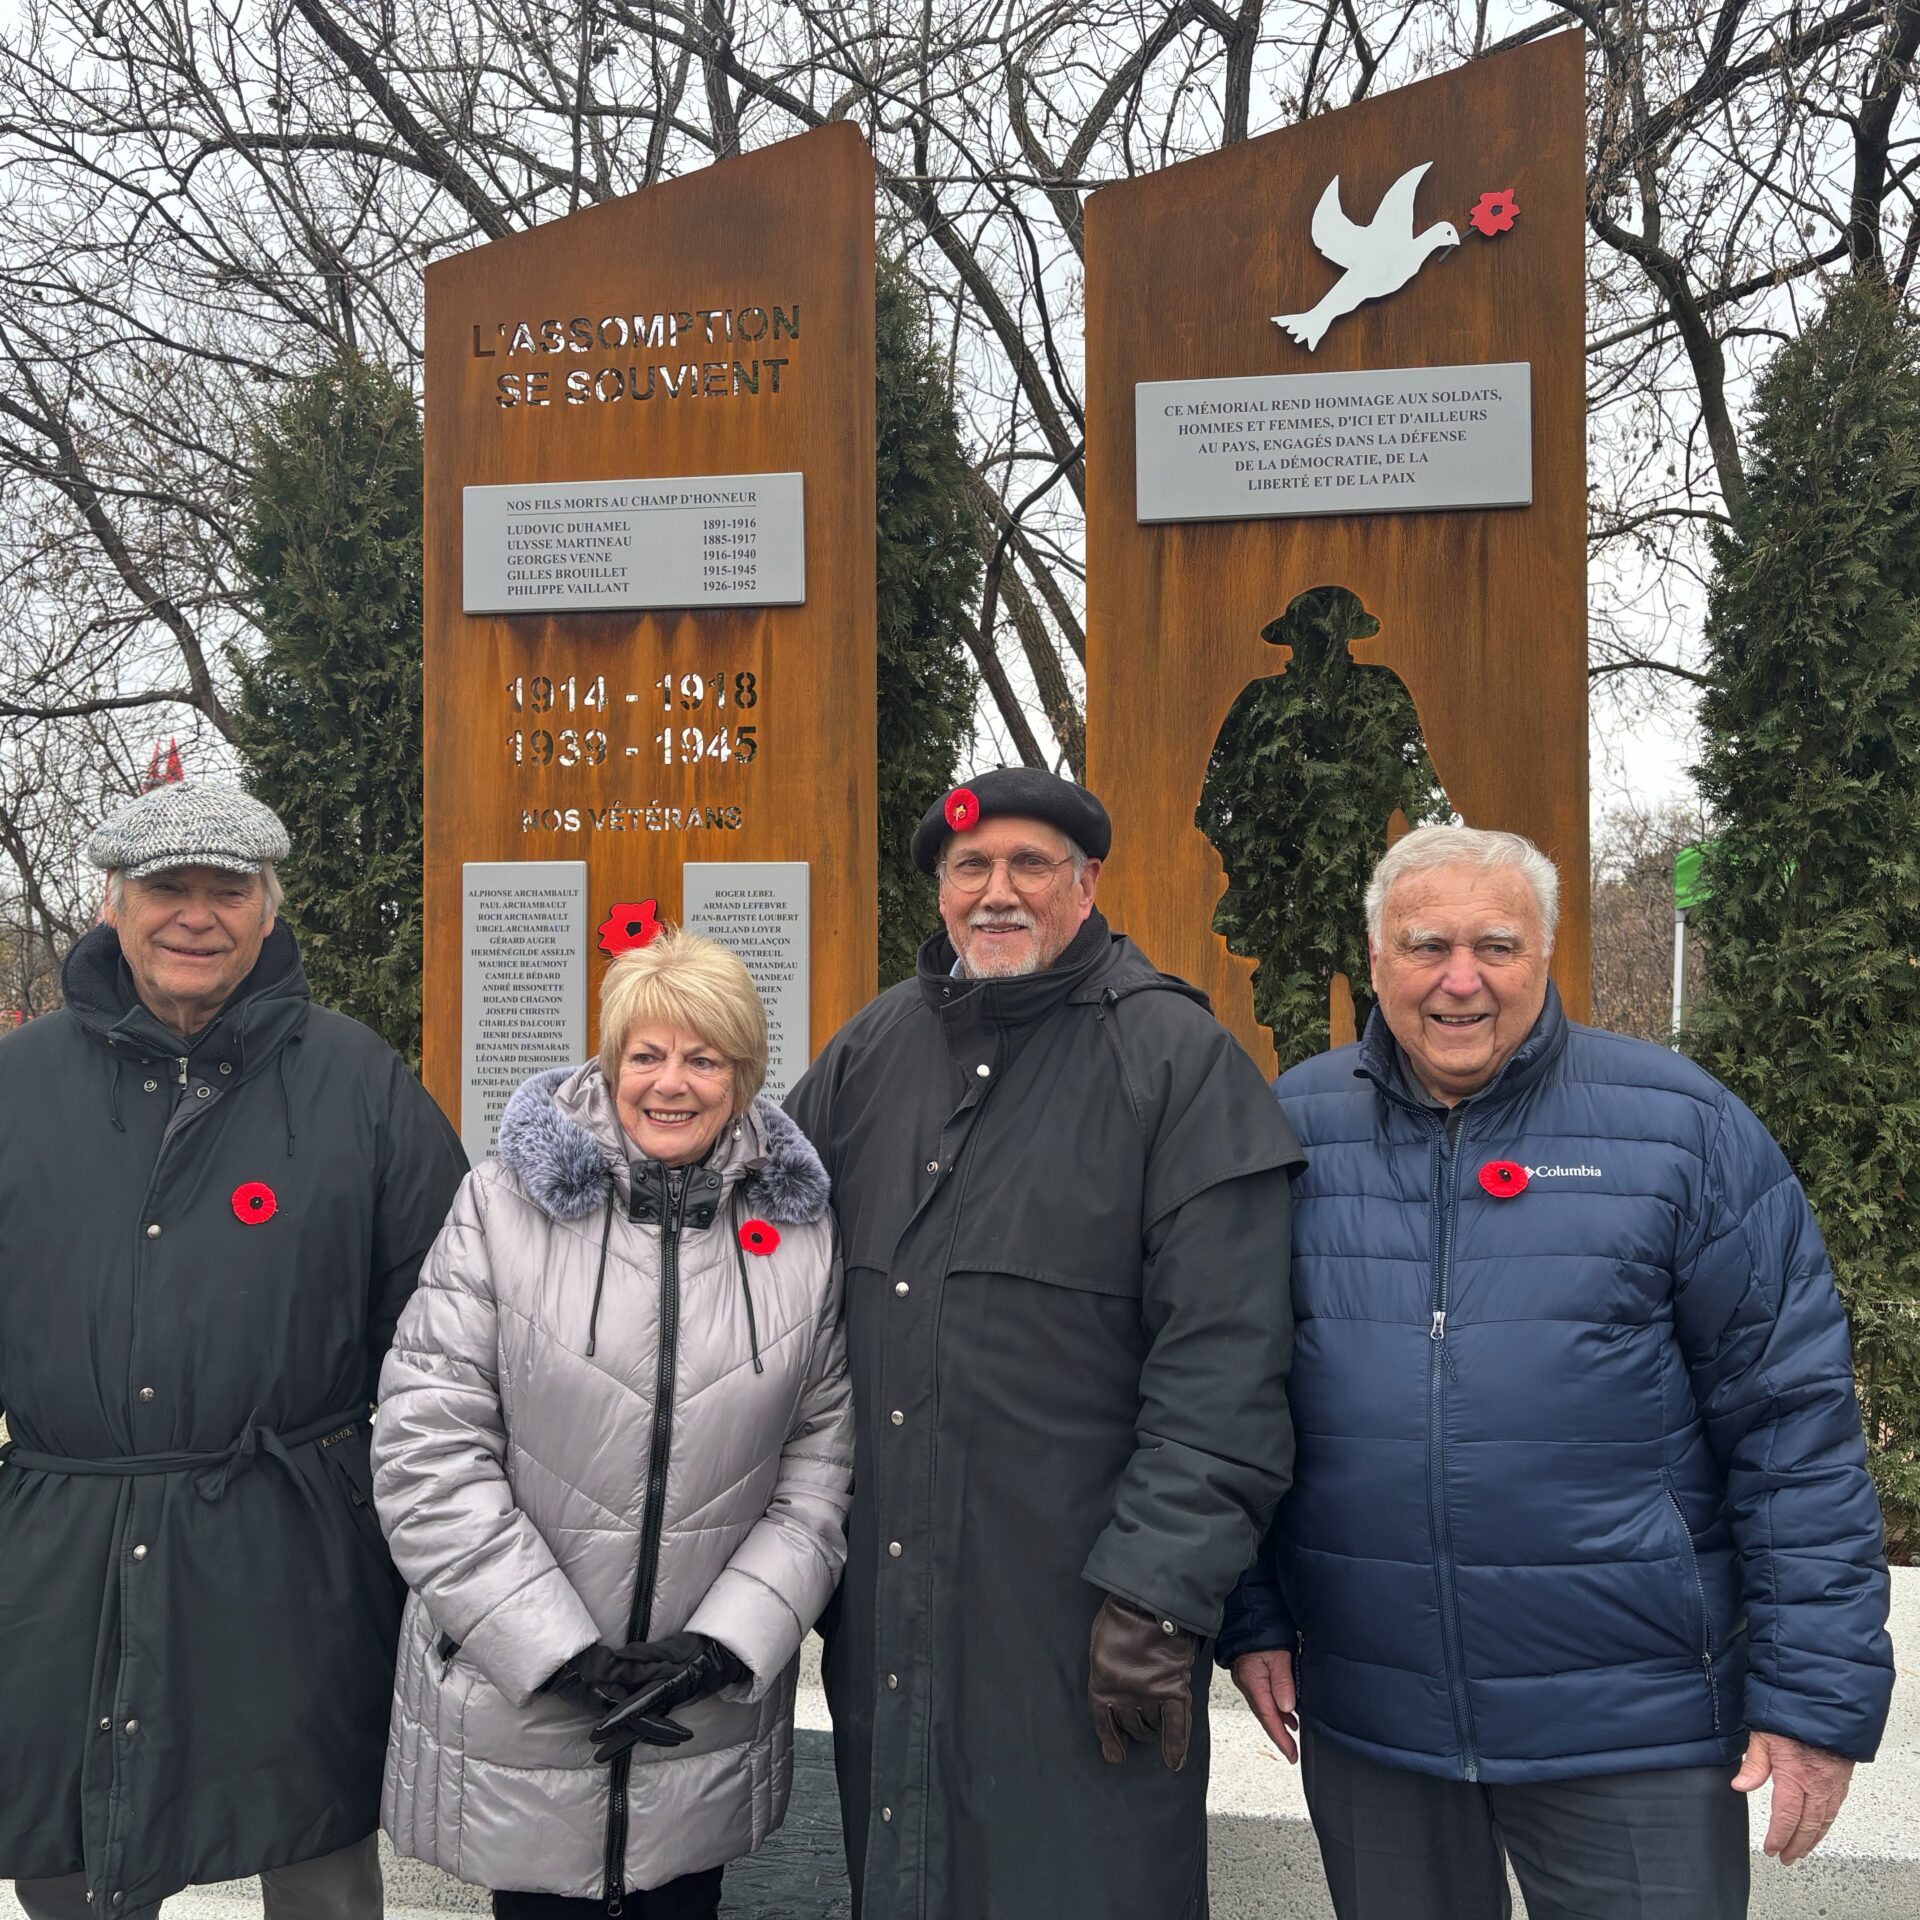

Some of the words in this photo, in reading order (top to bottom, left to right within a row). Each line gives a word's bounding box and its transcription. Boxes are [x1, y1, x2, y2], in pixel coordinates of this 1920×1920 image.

[473, 305, 800, 357] L'ASSOMPTION
[495, 371, 550, 408] SE
[565, 359, 789, 405] SOUVIENT
[1164, 405, 1183, 416] CE
[1187, 401, 1268, 415] MÉMORIAL
[1272, 399, 1310, 411] REND
[1316, 395, 1394, 408] HOMMAGE
[1398, 393, 1428, 404] AUX
[1432, 389, 1502, 402] SOLDATS,
[1179, 422, 1243, 435] HOMMES
[1247, 421, 1265, 432] ET
[1269, 417, 1334, 430] FEMMES,
[1338, 415, 1372, 427] D'ICI
[1377, 414, 1396, 425] ET
[1400, 410, 1488, 424] D'AILLEURS
[1199, 442, 1218, 454] AU
[1222, 440, 1259, 452] PAYS,
[1264, 435, 1332, 450] ENGAGÉS
[1336, 435, 1374, 447] DANS
[1378, 434, 1397, 444] LA
[1401, 430, 1467, 443] DÉFENSE
[1235, 460, 1254, 471] DE
[1258, 460, 1276, 470] LA
[1280, 453, 1382, 469] DÉMOCRATIE,
[1386, 453, 1405, 464] DE
[1410, 452, 1428, 463] LA
[1248, 475, 1310, 490] LIBERTÉ
[1314, 476, 1332, 488] ET
[1336, 475, 1355, 486] DE
[1359, 474, 1378, 485] LA
[1382, 472, 1416, 484] PAIX
[506, 501, 531, 511] NOS
[535, 500, 561, 510] FILS
[564, 498, 608, 509] MORTS
[611, 497, 628, 507] AU
[631, 495, 678, 506] CHAMP
[507, 524, 564, 535] LUDOVIC
[567, 522, 630, 532] DUHAMEL
[704, 518, 756, 529] 1891-1916
[507, 540, 552, 550] ULYSSE
[556, 537, 632, 548] MARTINEAU
[704, 534, 756, 545] 1885-1917
[507, 554, 566, 565] GEORGES
[570, 553, 612, 563] VENNE
[704, 549, 756, 560] 1916-1940
[507, 570, 552, 580] GILLES
[555, 567, 628, 579] BROUILLET
[704, 565, 756, 576] 1915-1945
[507, 585, 564, 596] PHILIPPE
[567, 582, 630, 594] VAILLANT
[704, 580, 756, 591] 1926-1952
[506, 675, 608, 713] 1914
[655, 672, 757, 711] 1918
[506, 729, 607, 767] 1939
[655, 726, 757, 765] 1945
[521, 808, 580, 832] NOS
[588, 800, 742, 831] VÉTÉRANS
[490, 936, 525, 944] GÉRARD
[471, 948, 538, 956] HERMÉNÉGILDE
[482, 983, 511, 991] ANDRÉ
[476, 1043, 519, 1051] BENJAMIN
[476, 1054, 516, 1062] LÉONARD
[471, 1078, 520, 1086] HENRI-PAUL
[1536, 1165, 1601, 1177] Columbia
[322, 1428, 352, 1447] KANUK
